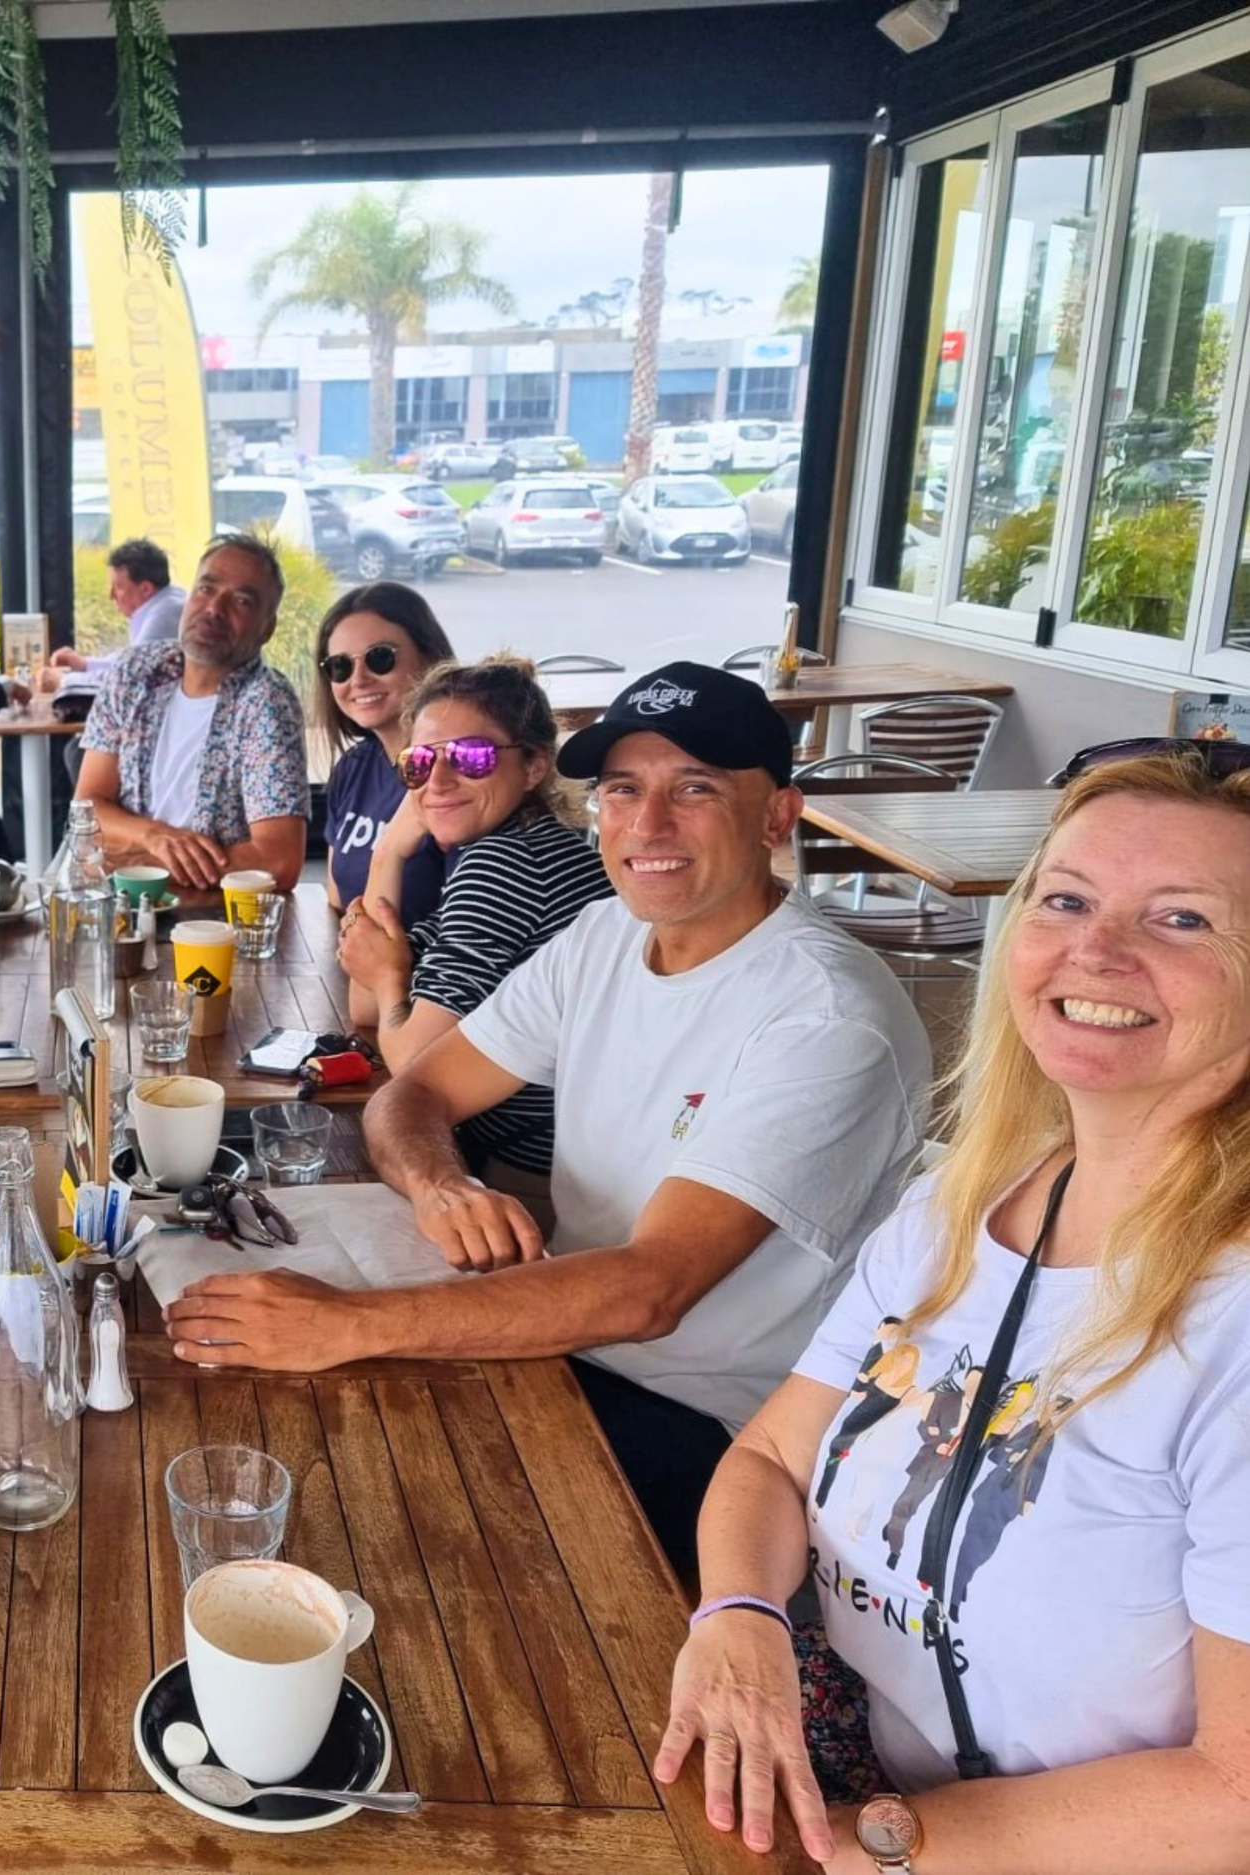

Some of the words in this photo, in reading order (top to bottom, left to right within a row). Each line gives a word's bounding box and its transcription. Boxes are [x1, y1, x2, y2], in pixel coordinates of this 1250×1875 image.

[120, 249, 178, 575] COLUMBU
[627, 688, 659, 705] LUCAS
[659, 687, 698, 702] CREEK
[192, 976, 211, 994] C
